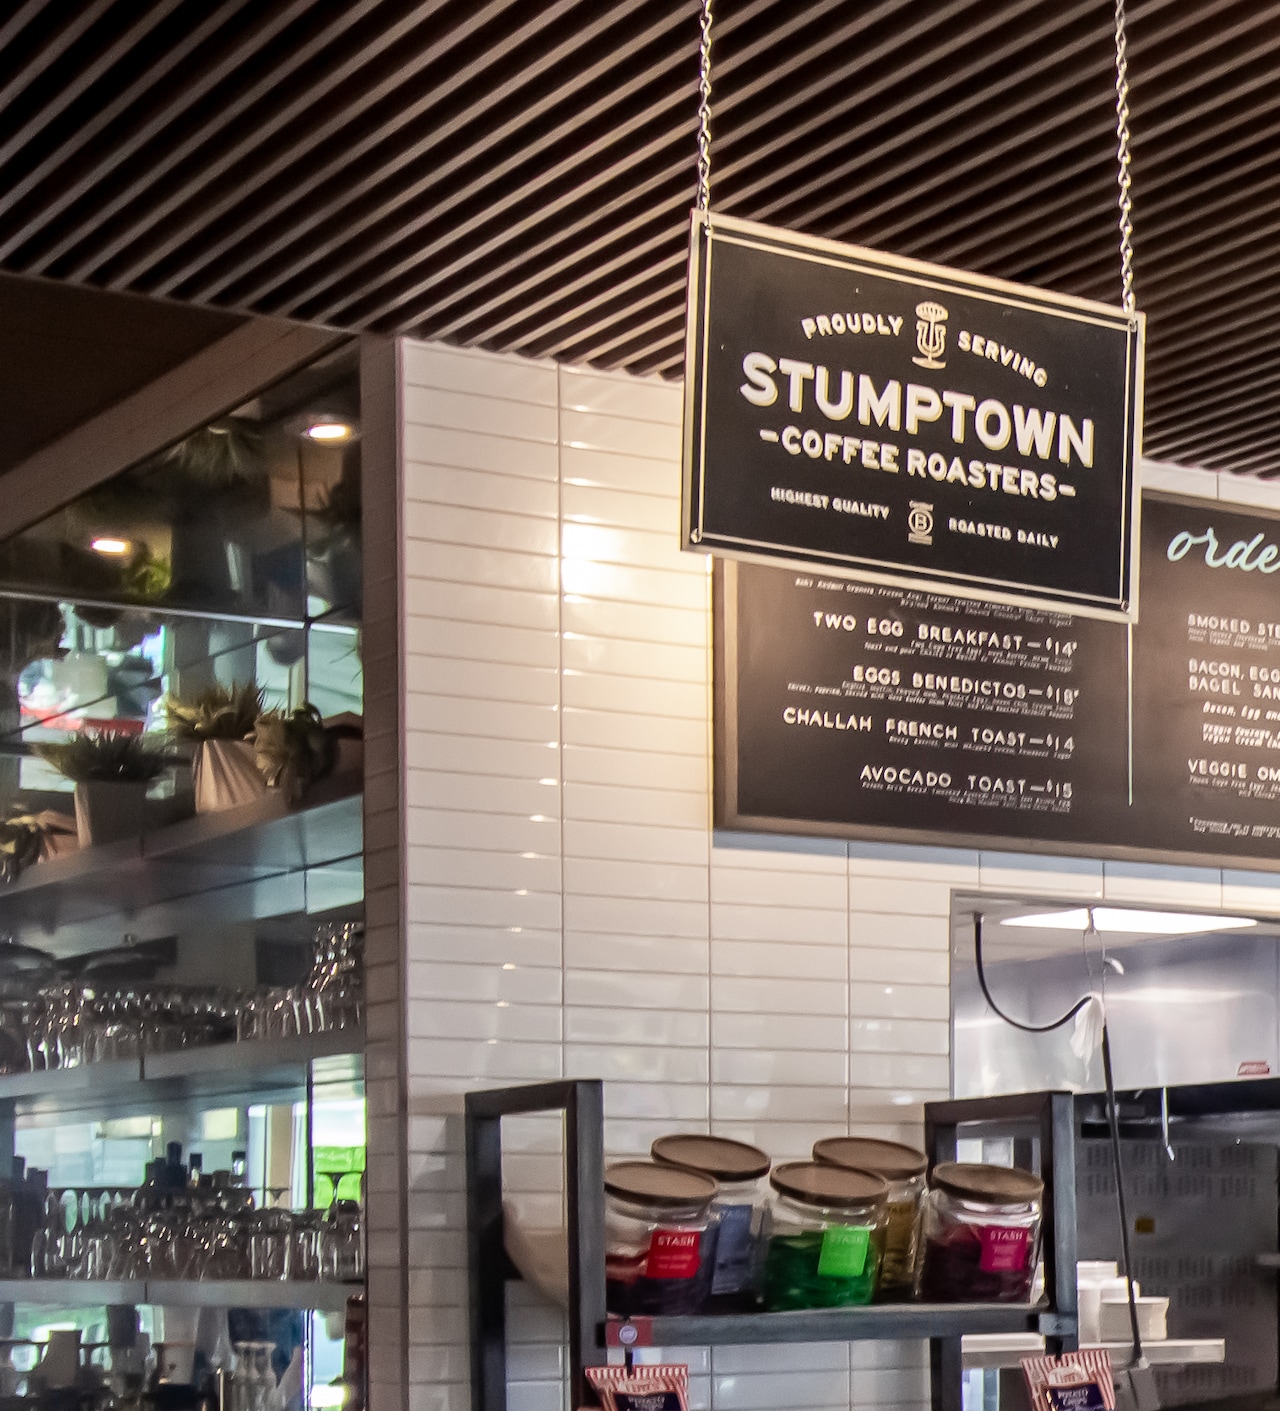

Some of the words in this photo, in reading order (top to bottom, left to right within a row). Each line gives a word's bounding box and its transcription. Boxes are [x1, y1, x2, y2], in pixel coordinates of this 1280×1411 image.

[801, 313, 903, 339] PROUDLY
[958, 331, 1047, 387] SERVING
[740, 351, 1095, 468] STUMPTOWN
[771, 487, 828, 509] HIGHEST
[833, 497, 890, 520] QUALITY
[949, 517, 1011, 541] ROASTED
[1017, 529, 1059, 548] DAILY
[813, 611, 856, 632] TWO
[867, 617, 904, 637] EGG
[918, 623, 1023, 651] BREAKFAST
[1188, 613, 1250, 634] SMOKED
[853, 665, 901, 686] EGGS
[1188, 657, 1244, 680] BACON,
[1250, 665, 1280, 683] EGG
[1188, 674, 1241, 696] BAGEL
[1241, 704, 1260, 721] Egg
[783, 707, 873, 732] CHALLAH
[886, 718, 958, 741] FRENCH
[972, 728, 1026, 747] TOAST
[1235, 735, 1263, 749] Cream
[860, 765, 952, 788] AVOCADO
[968, 774, 1026, 794] TOAST
[1188, 758, 1247, 779] VEGGIE
[989, 1229, 1023, 1241] STASH
